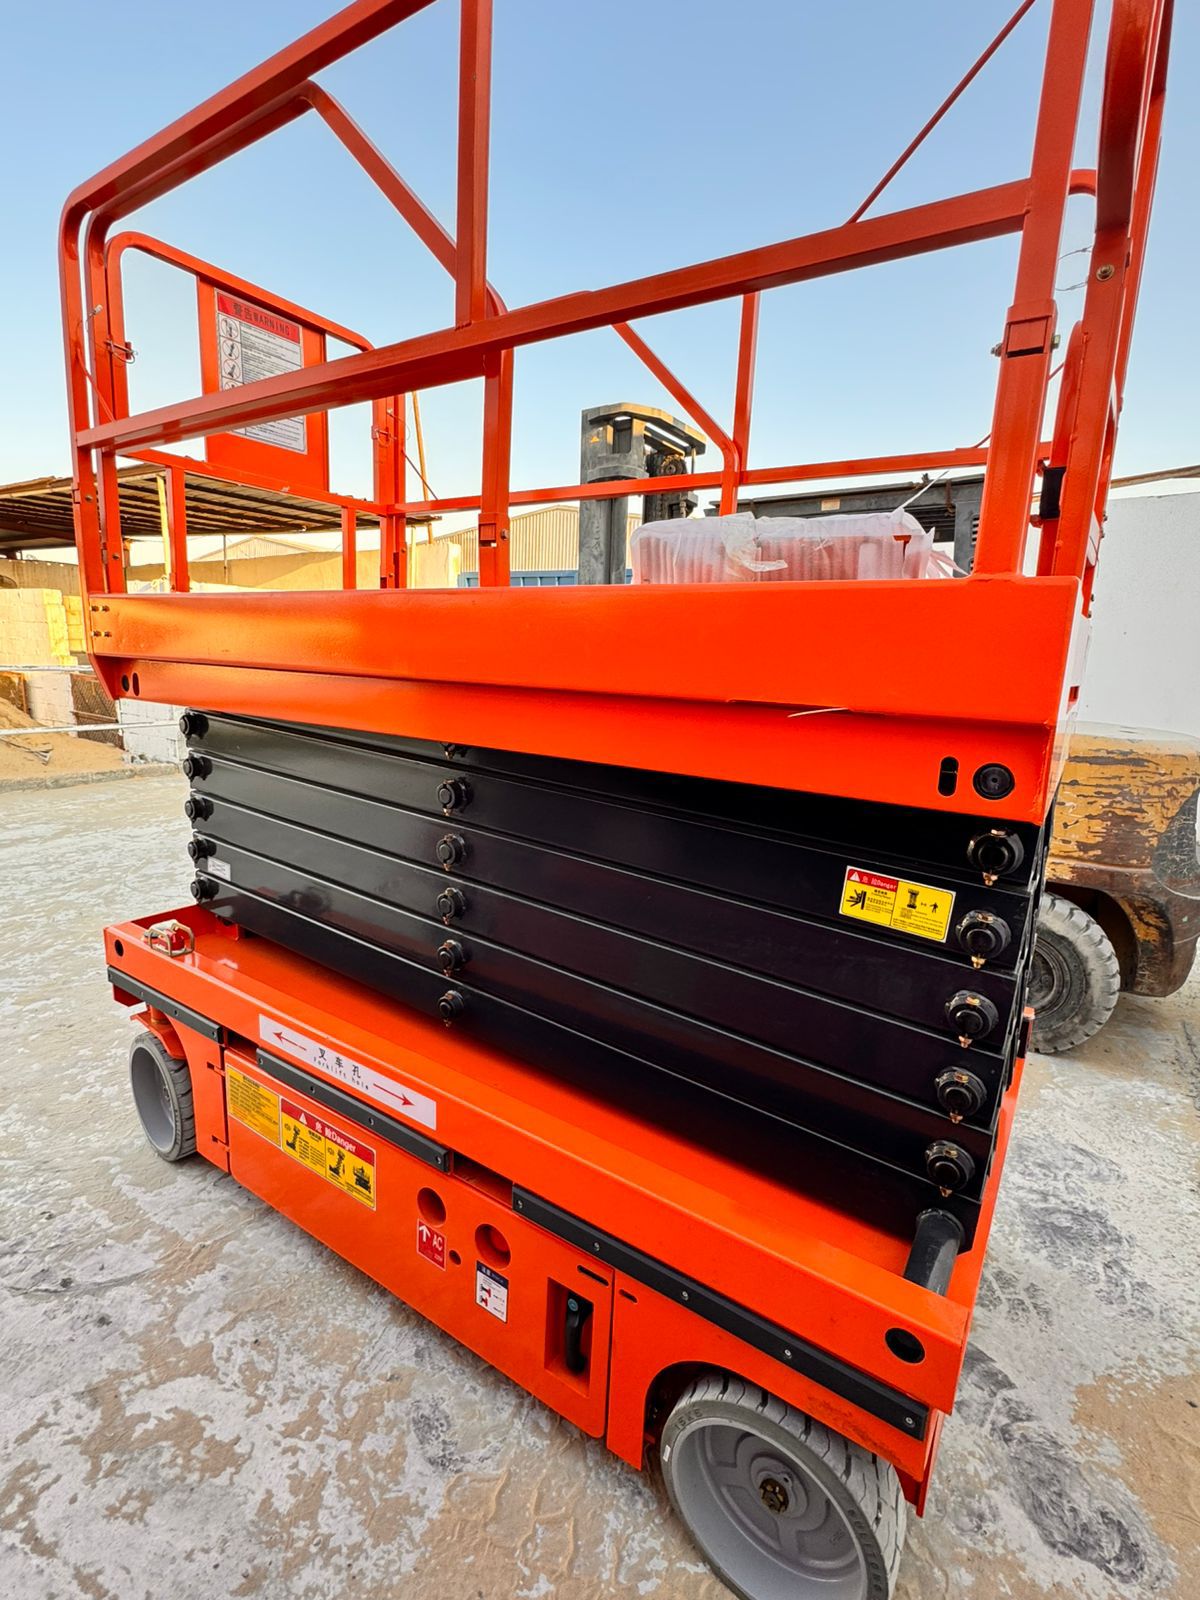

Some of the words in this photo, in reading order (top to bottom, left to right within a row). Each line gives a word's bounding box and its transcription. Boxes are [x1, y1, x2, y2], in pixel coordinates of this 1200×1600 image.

[253, 311, 290, 337] WARNING
[318, 1047, 361, 1079] 叉车孔
[331, 1130, 356, 1154] Danger
